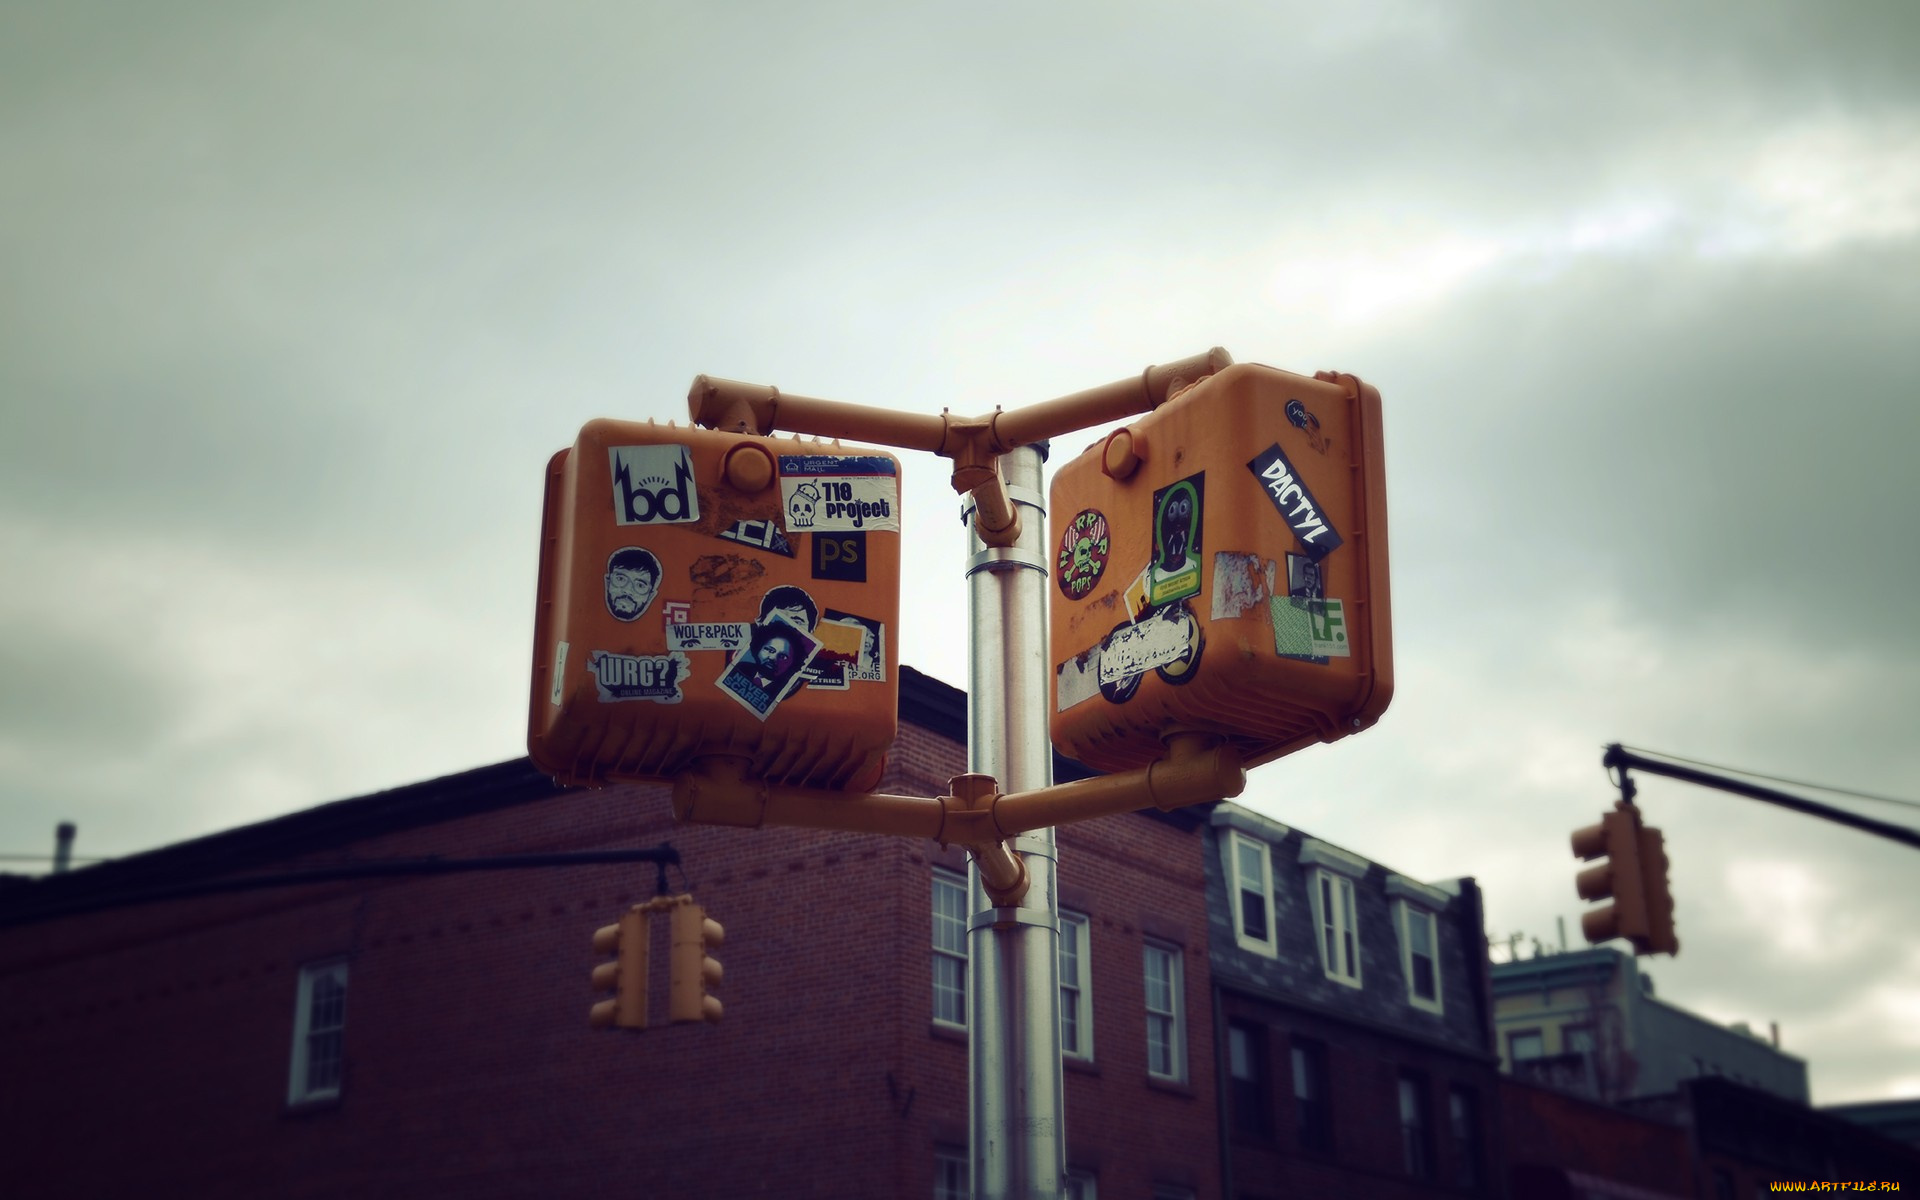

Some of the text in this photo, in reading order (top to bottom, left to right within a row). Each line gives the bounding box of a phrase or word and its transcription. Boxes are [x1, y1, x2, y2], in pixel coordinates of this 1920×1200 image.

[826, 498, 890, 527] project
[1261, 458, 1329, 544] DACTYL
[1071, 575, 1092, 594] POPS
[674, 624, 743, 639] WOLF&PACK
[599, 657, 670, 687] WRG?
[733, 672, 769, 702] NEVER
[724, 676, 767, 712] SCARED
